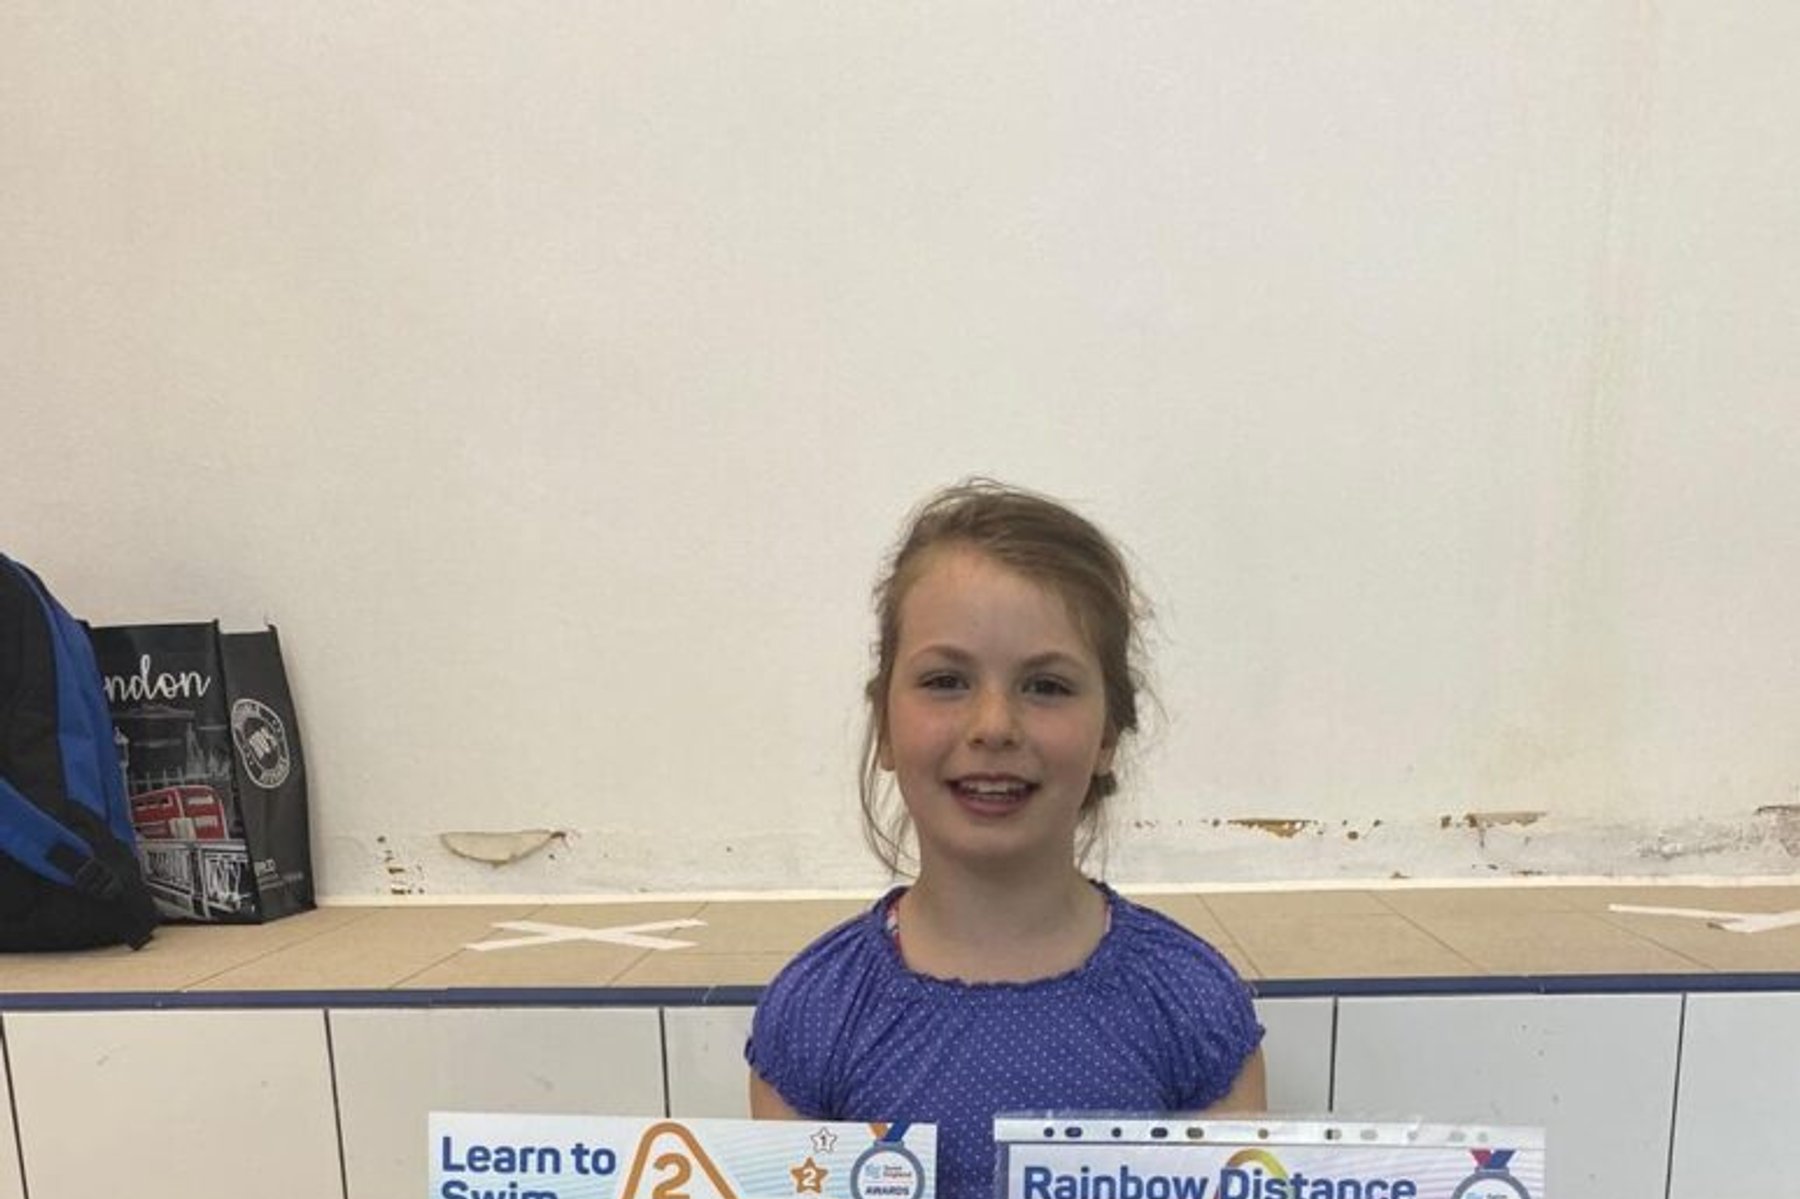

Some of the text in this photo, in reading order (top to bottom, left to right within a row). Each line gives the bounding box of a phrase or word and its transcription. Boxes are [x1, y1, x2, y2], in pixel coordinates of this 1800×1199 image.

[103, 654, 211, 703] ndon
[442, 1136, 617, 1176] Learn to
[802, 1169, 817, 1187] 2
[865, 1186, 909, 1196] AWARDS
